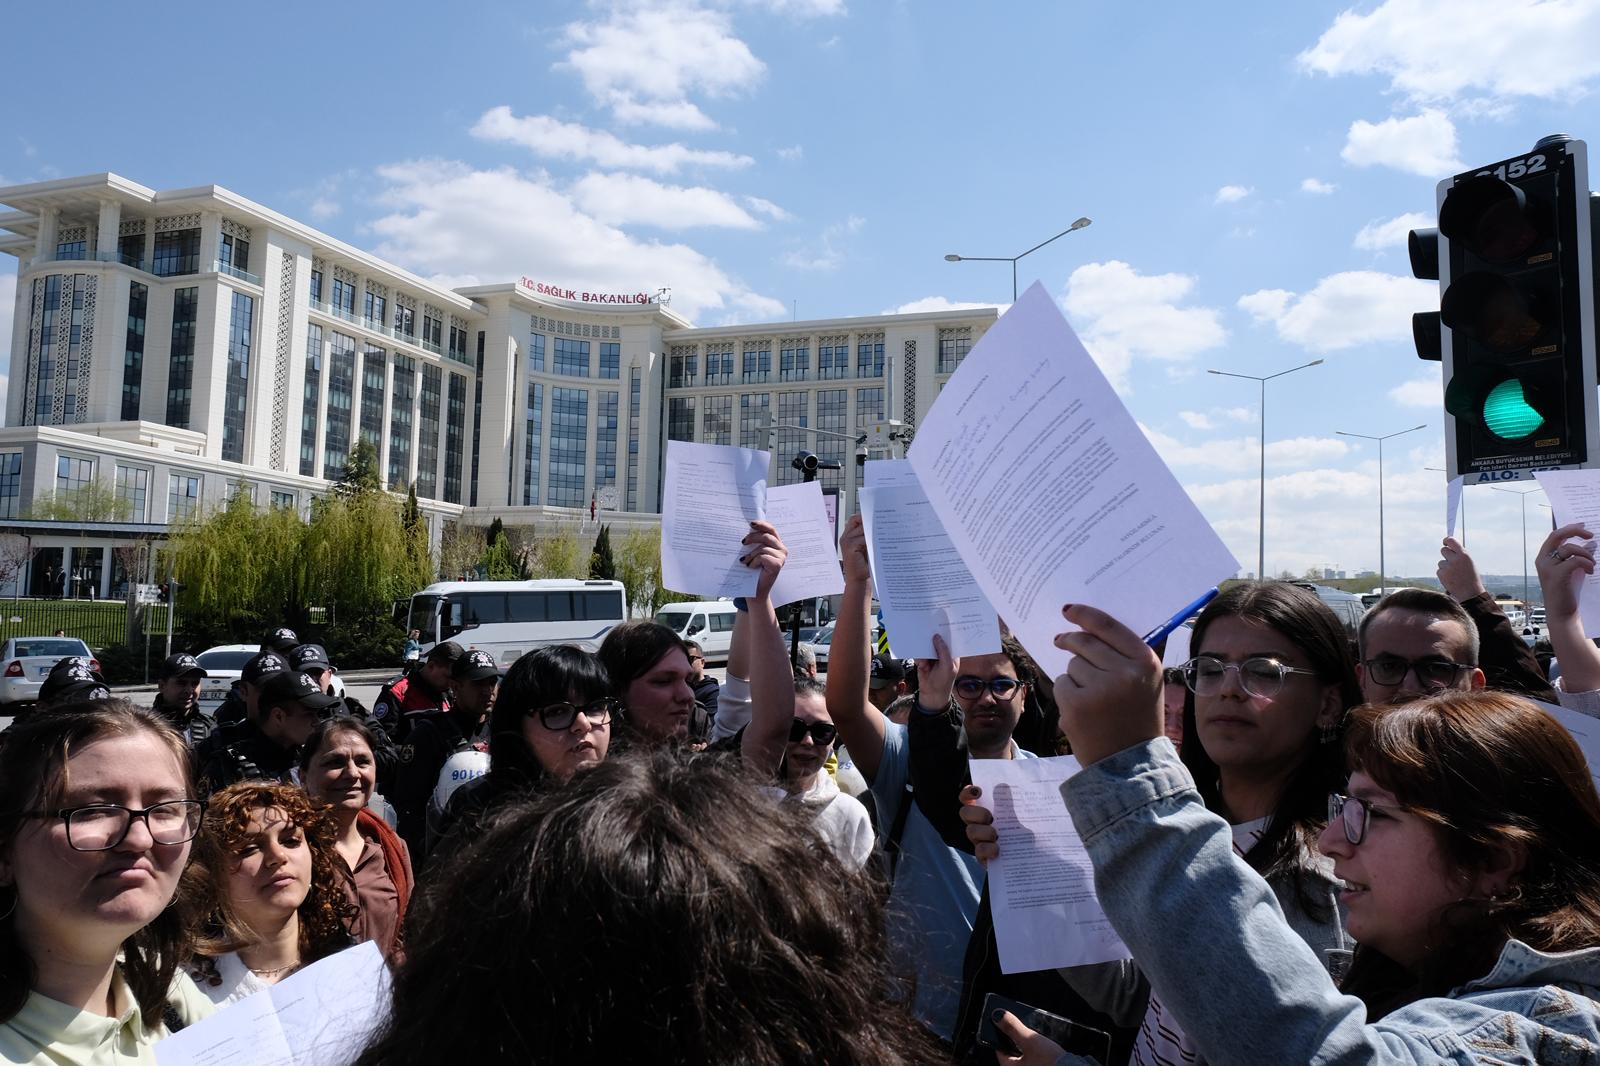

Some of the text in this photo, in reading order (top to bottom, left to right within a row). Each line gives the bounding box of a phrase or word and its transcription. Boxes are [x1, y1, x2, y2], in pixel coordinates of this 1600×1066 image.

[1475, 154, 1547, 181] 152
[521, 276, 648, 304] T.C. SAĞLIK BAKANLIĞI
[1471, 459, 1495, 467] ANKARA
[1478, 470, 1519, 482] ALO:
